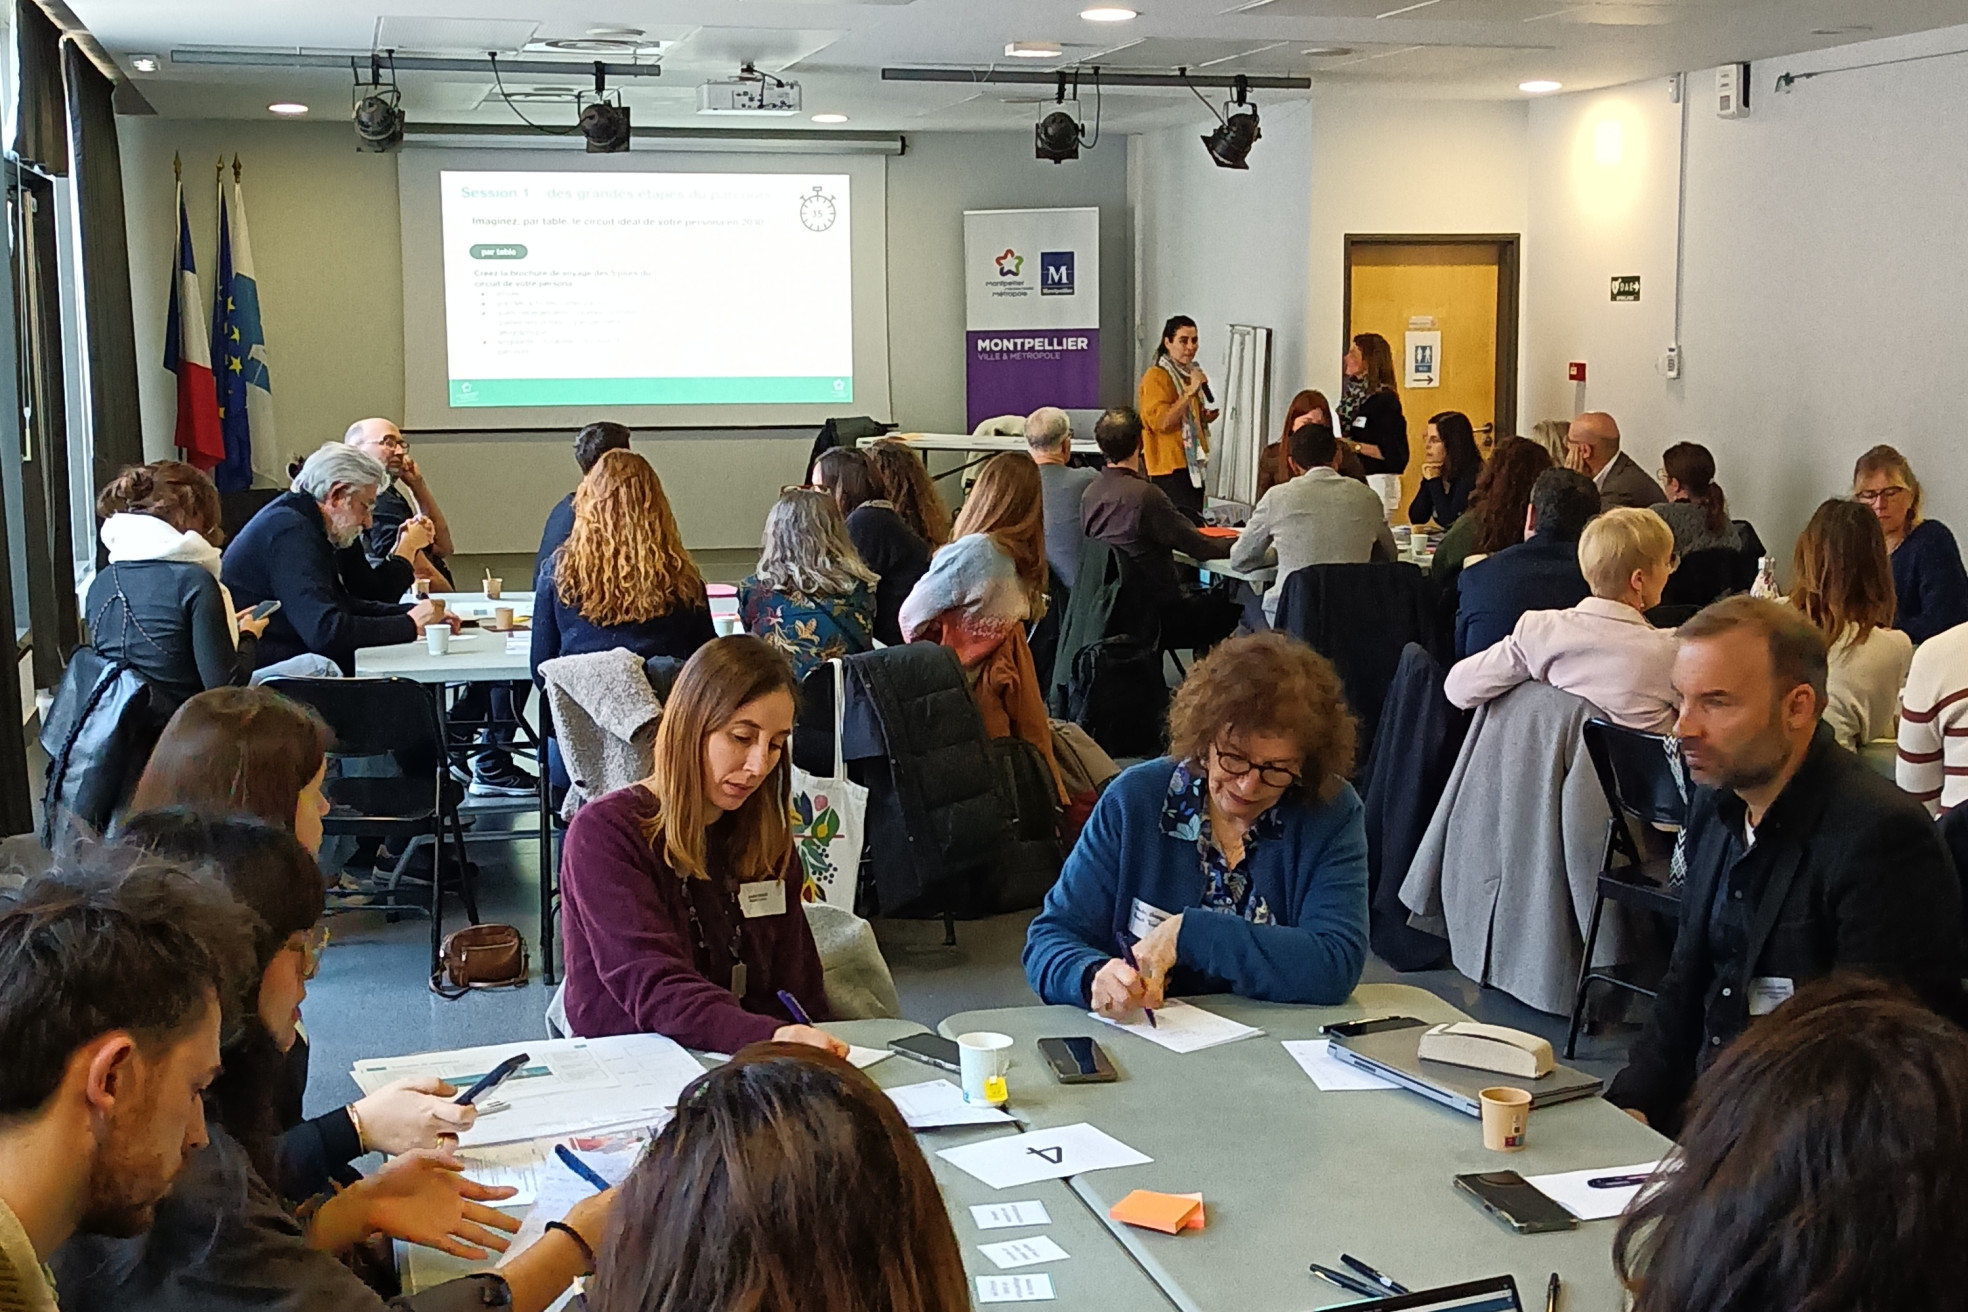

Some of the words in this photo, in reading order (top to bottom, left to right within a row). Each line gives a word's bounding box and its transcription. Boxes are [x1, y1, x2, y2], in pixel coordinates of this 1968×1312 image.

[461, 185, 518, 199] Session
[523, 187, 530, 198] 1
[547, 187, 573, 199] des
[523, 217, 539, 227] par
[584, 217, 615, 226] circuit
[643, 217, 656, 226] de
[658, 217, 682, 226] votre
[480, 248, 495, 258] par
[496, 247, 517, 256] table
[1047, 265, 1069, 284] M
[977, 337, 1088, 351] MONTPELLIER
[977, 352, 1000, 361] VILLE
[1026, 1145, 1063, 1164] 4
